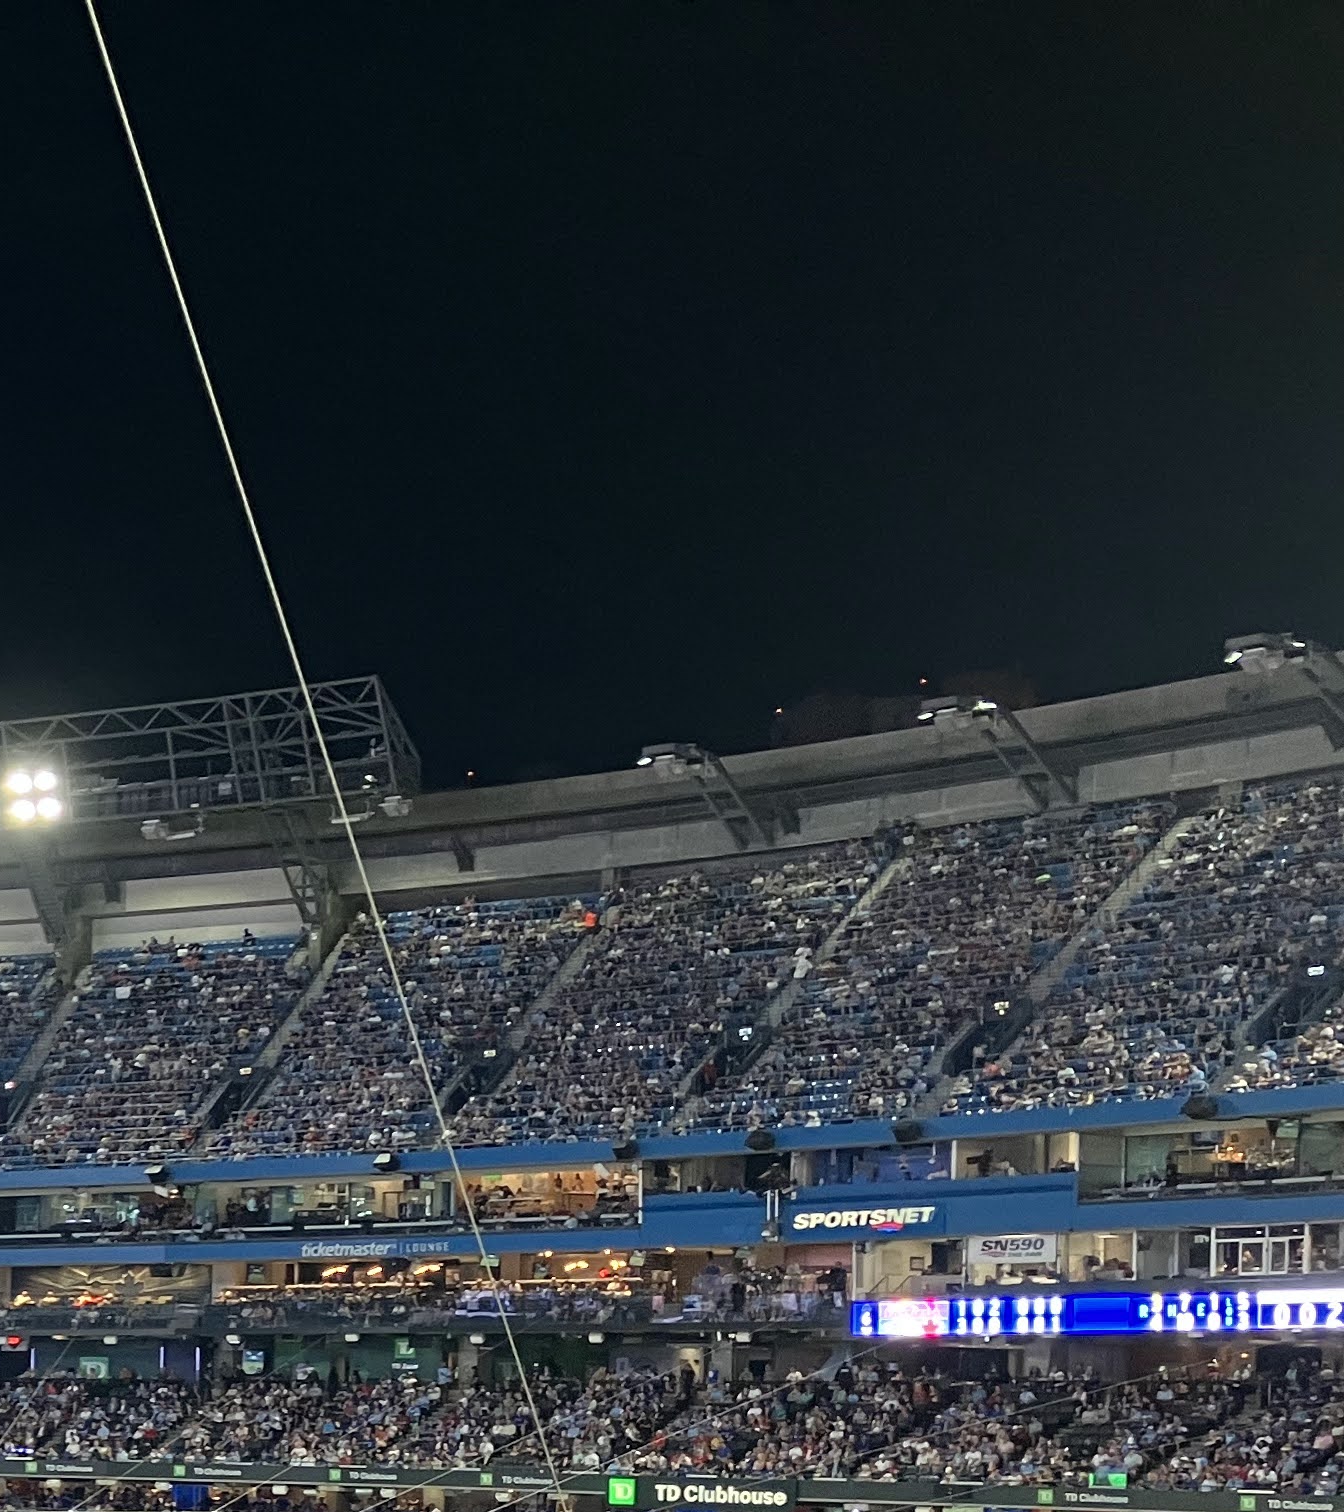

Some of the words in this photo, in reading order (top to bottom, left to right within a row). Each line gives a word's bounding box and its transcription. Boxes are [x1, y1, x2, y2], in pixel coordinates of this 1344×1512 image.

[792, 1207, 935, 1230] SPORTSNET
[301, 1242, 392, 1257] ticketmaster
[407, 1242, 450, 1253] LOUNGE
[981, 1238, 1045, 1252] SN590
[655, 1483, 681, 1501] TD
[683, 1483, 788, 1506] Clubhouse
